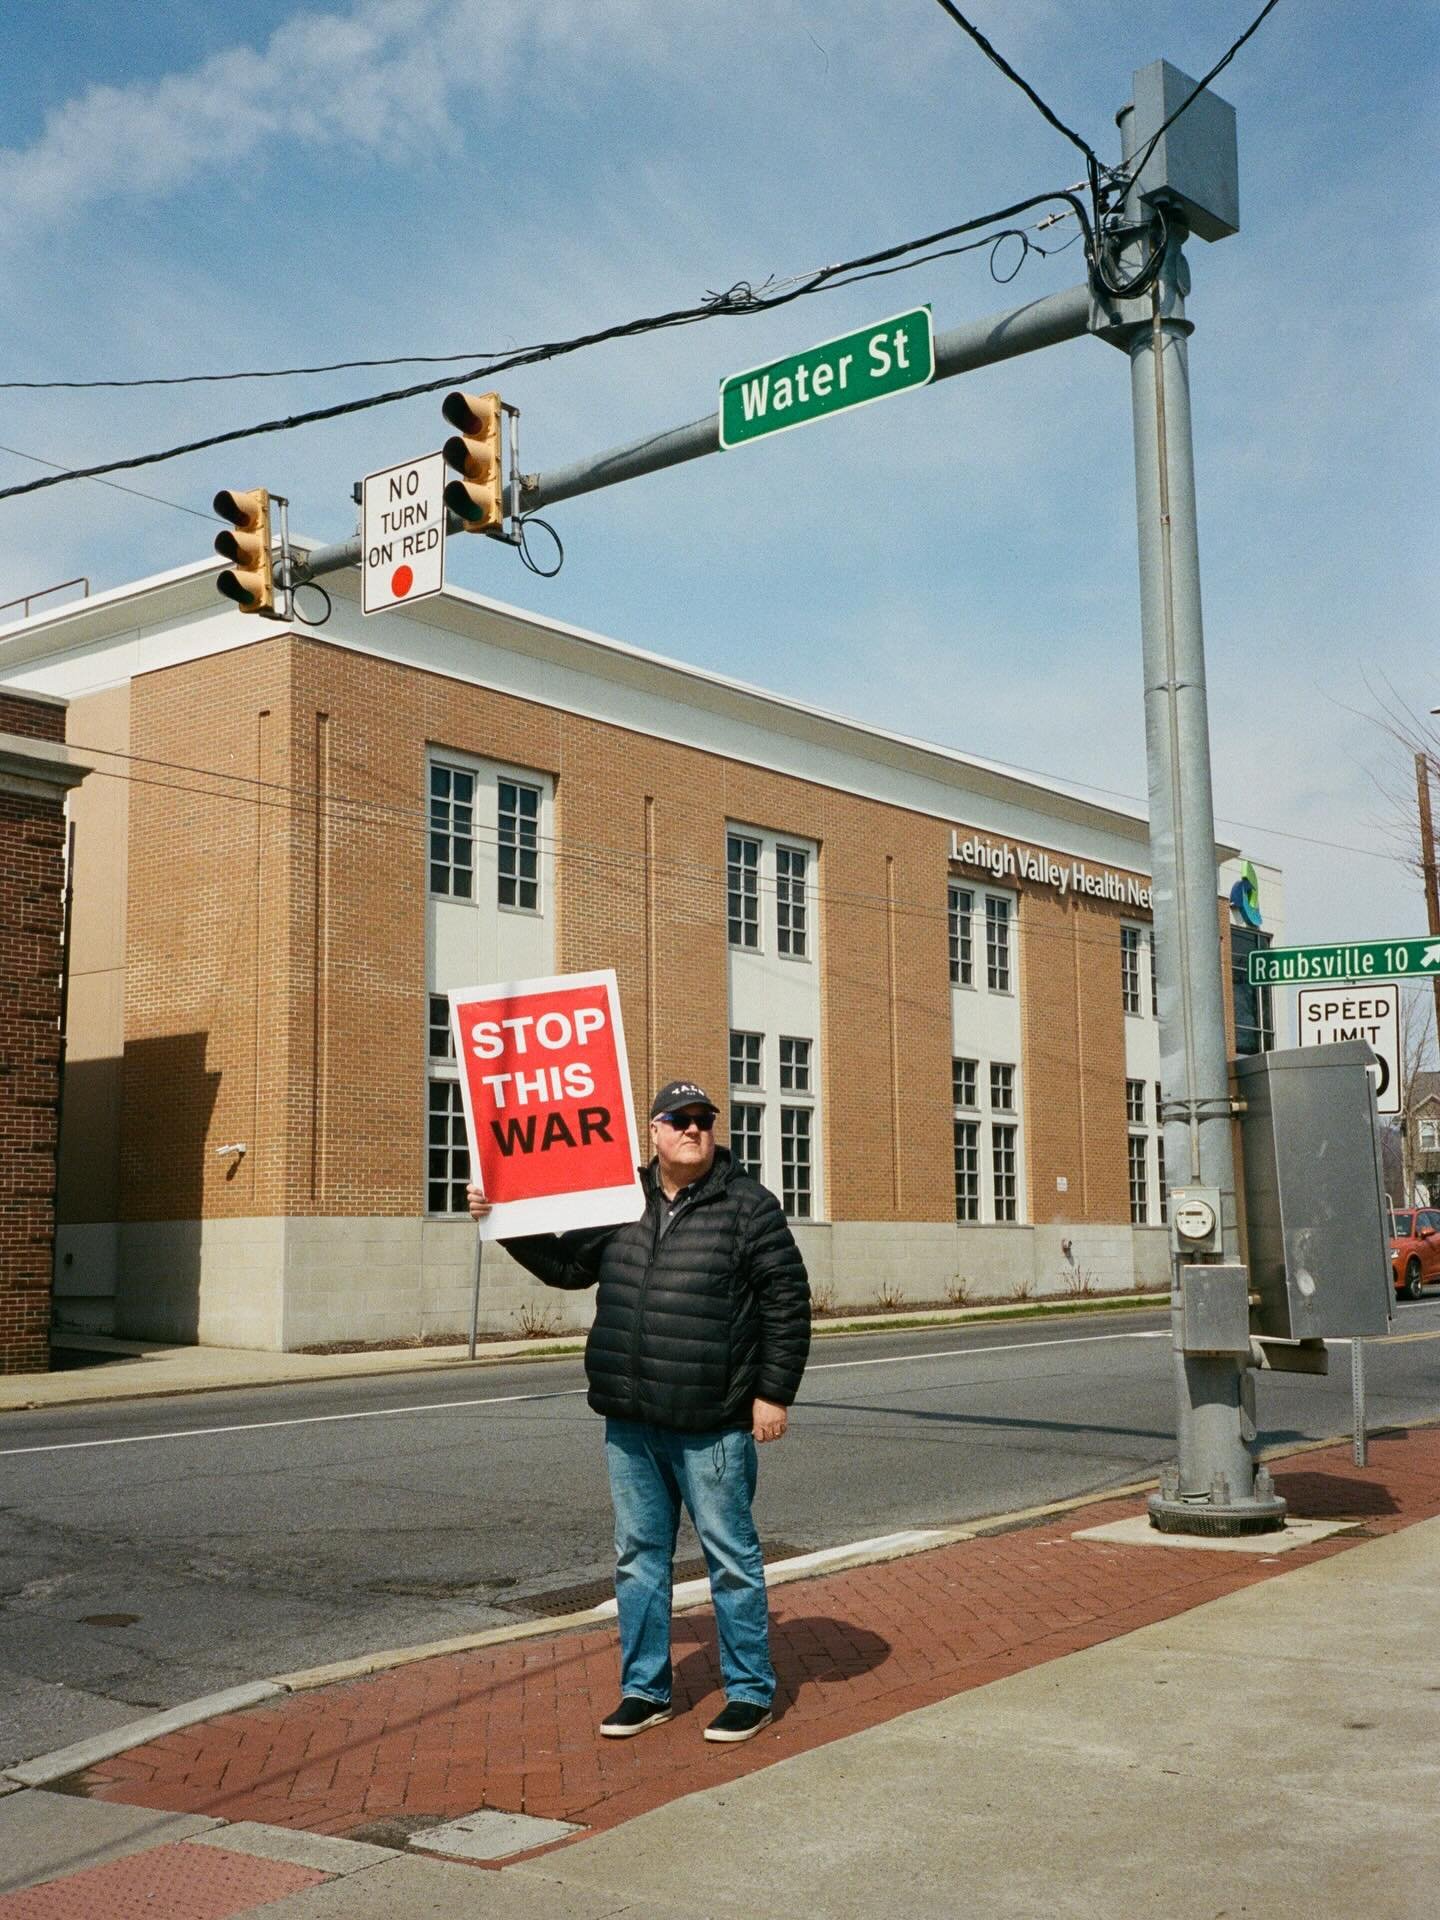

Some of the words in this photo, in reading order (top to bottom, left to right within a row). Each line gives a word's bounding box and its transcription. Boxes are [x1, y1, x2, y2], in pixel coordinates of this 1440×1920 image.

[741, 354, 853, 421] Water
[868, 329, 910, 378] St
[389, 470, 419, 502] NO
[381, 500, 428, 535] TURN
[369, 542, 393, 568] ON
[403, 528, 439, 558] RED
[950, 830, 1015, 878] Lehigh
[1016, 847, 1070, 894] Valley
[1072, 862, 1125, 902] Health
[1255, 949, 1374, 981] Raubsville
[1384, 947, 1408, 973] 10
[1308, 999, 1390, 1022] SPEED
[471, 1007, 606, 1060] STOP
[482, 1062, 596, 1109] THIS
[490, 1106, 615, 1158] WAR
